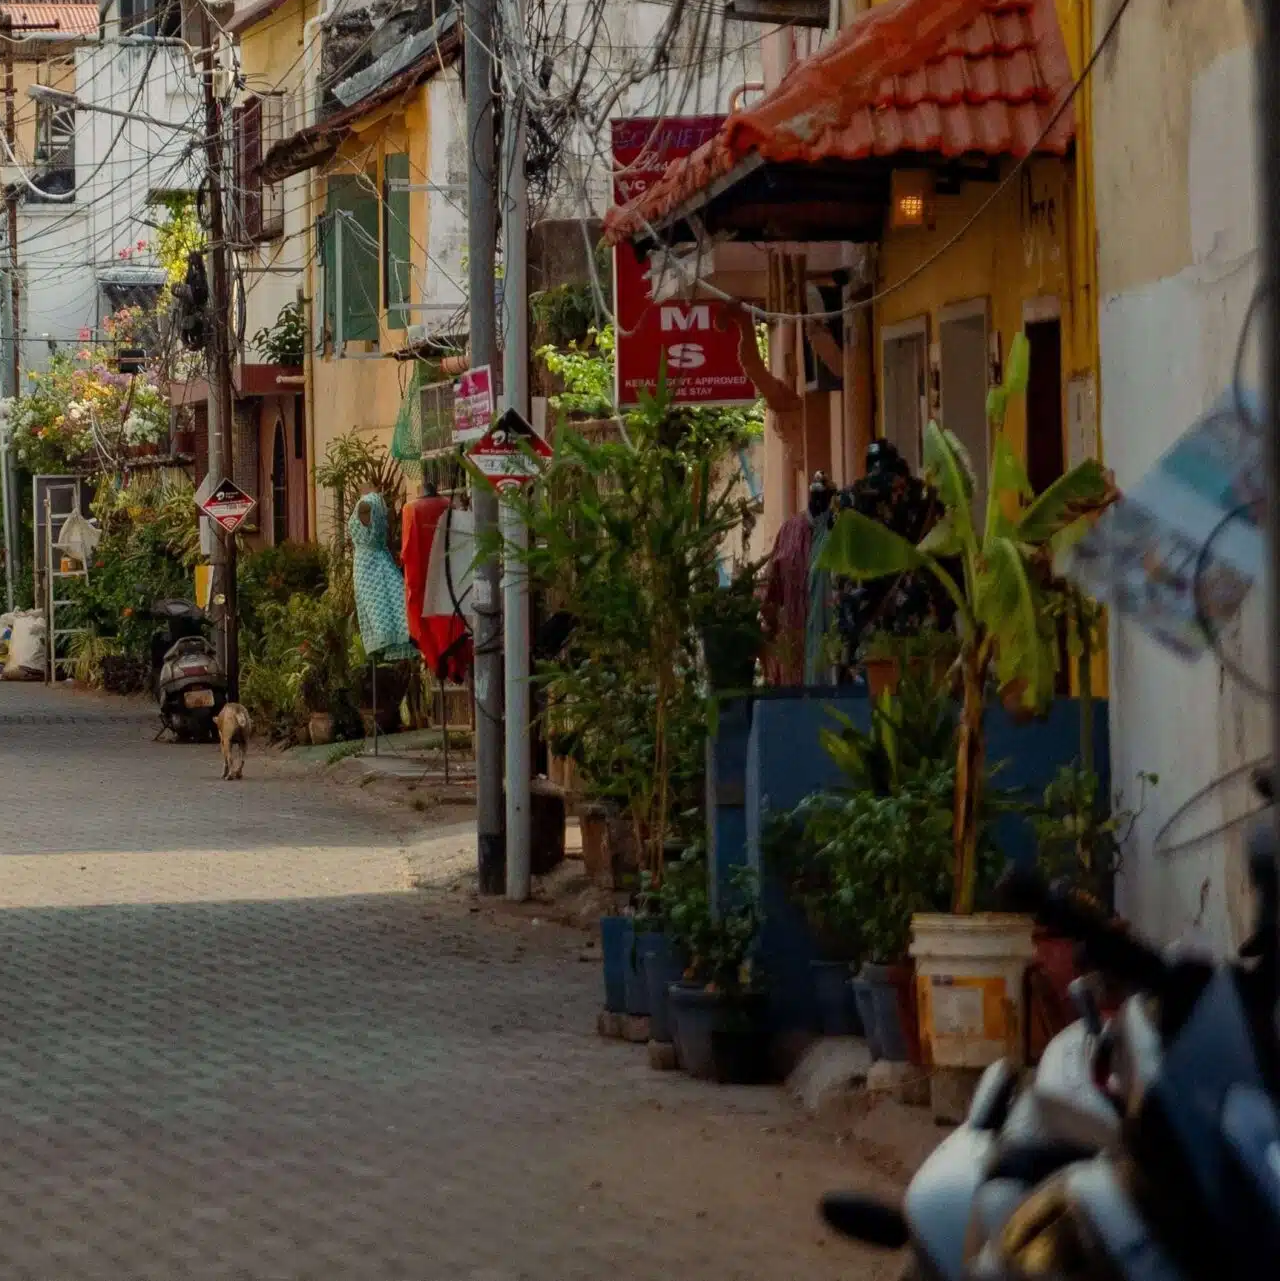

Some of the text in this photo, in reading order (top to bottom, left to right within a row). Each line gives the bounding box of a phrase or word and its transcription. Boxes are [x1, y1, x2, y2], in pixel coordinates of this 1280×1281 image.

[624, 378, 658, 388] KERAL
[694, 376, 747, 385] APPROVED
[689, 387, 713, 396] STAY
